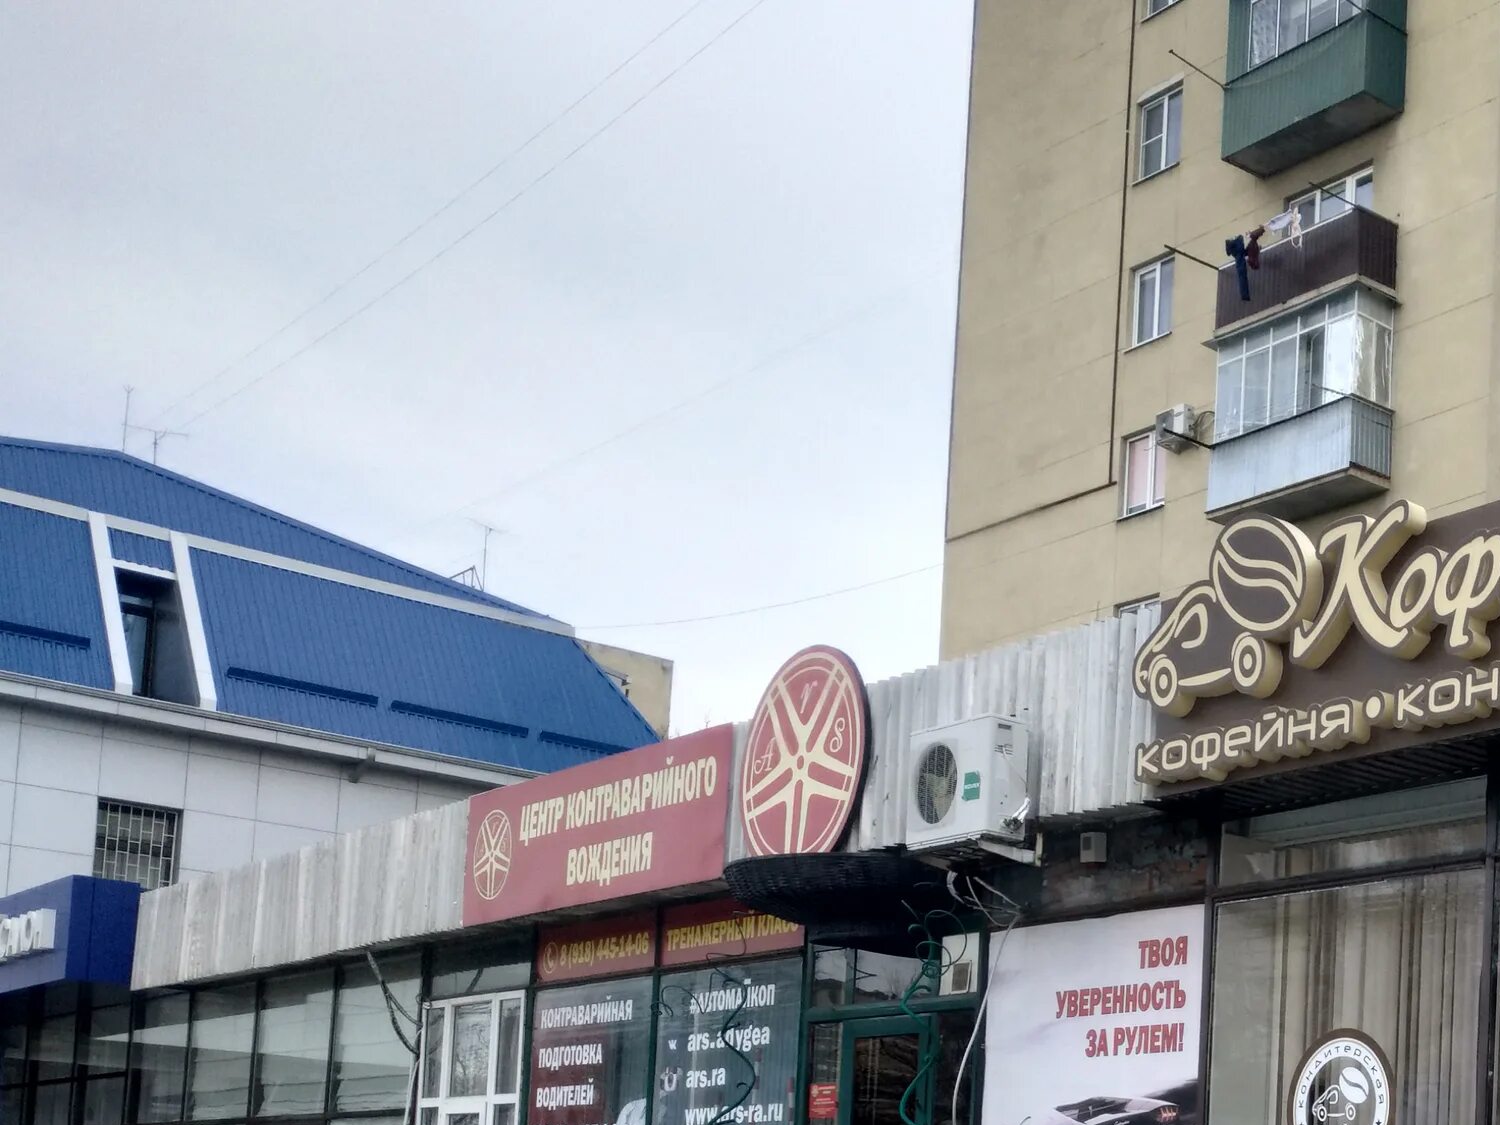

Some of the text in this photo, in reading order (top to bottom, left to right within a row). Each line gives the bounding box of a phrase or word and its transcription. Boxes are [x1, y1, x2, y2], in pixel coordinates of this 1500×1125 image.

[519, 755, 717, 847] ЦЕНТР КОНТРАВАРИЙНОГО
[566, 831, 654, 888] ВОЖДЕНИЯ
[597, 931, 649, 960] 445-14-06
[667, 909, 756, 952] ТРЕНАЖЕРНЫЙ
[1138, 935, 1189, 969] ТВОЯ
[540, 995, 634, 1030] КОНТРАВАРИЙНАЯ
[1055, 979, 1187, 1019] УВЕРЕННОСТЬ
[538, 1043, 603, 1071] ПОДГОТОВКА
[1084, 1022, 1185, 1058] ЗА РУЛЕМ!
[535, 1077, 595, 1111] ВОДИТЕЛЕЙ
[685, 1066, 726, 1089] ars.ra
